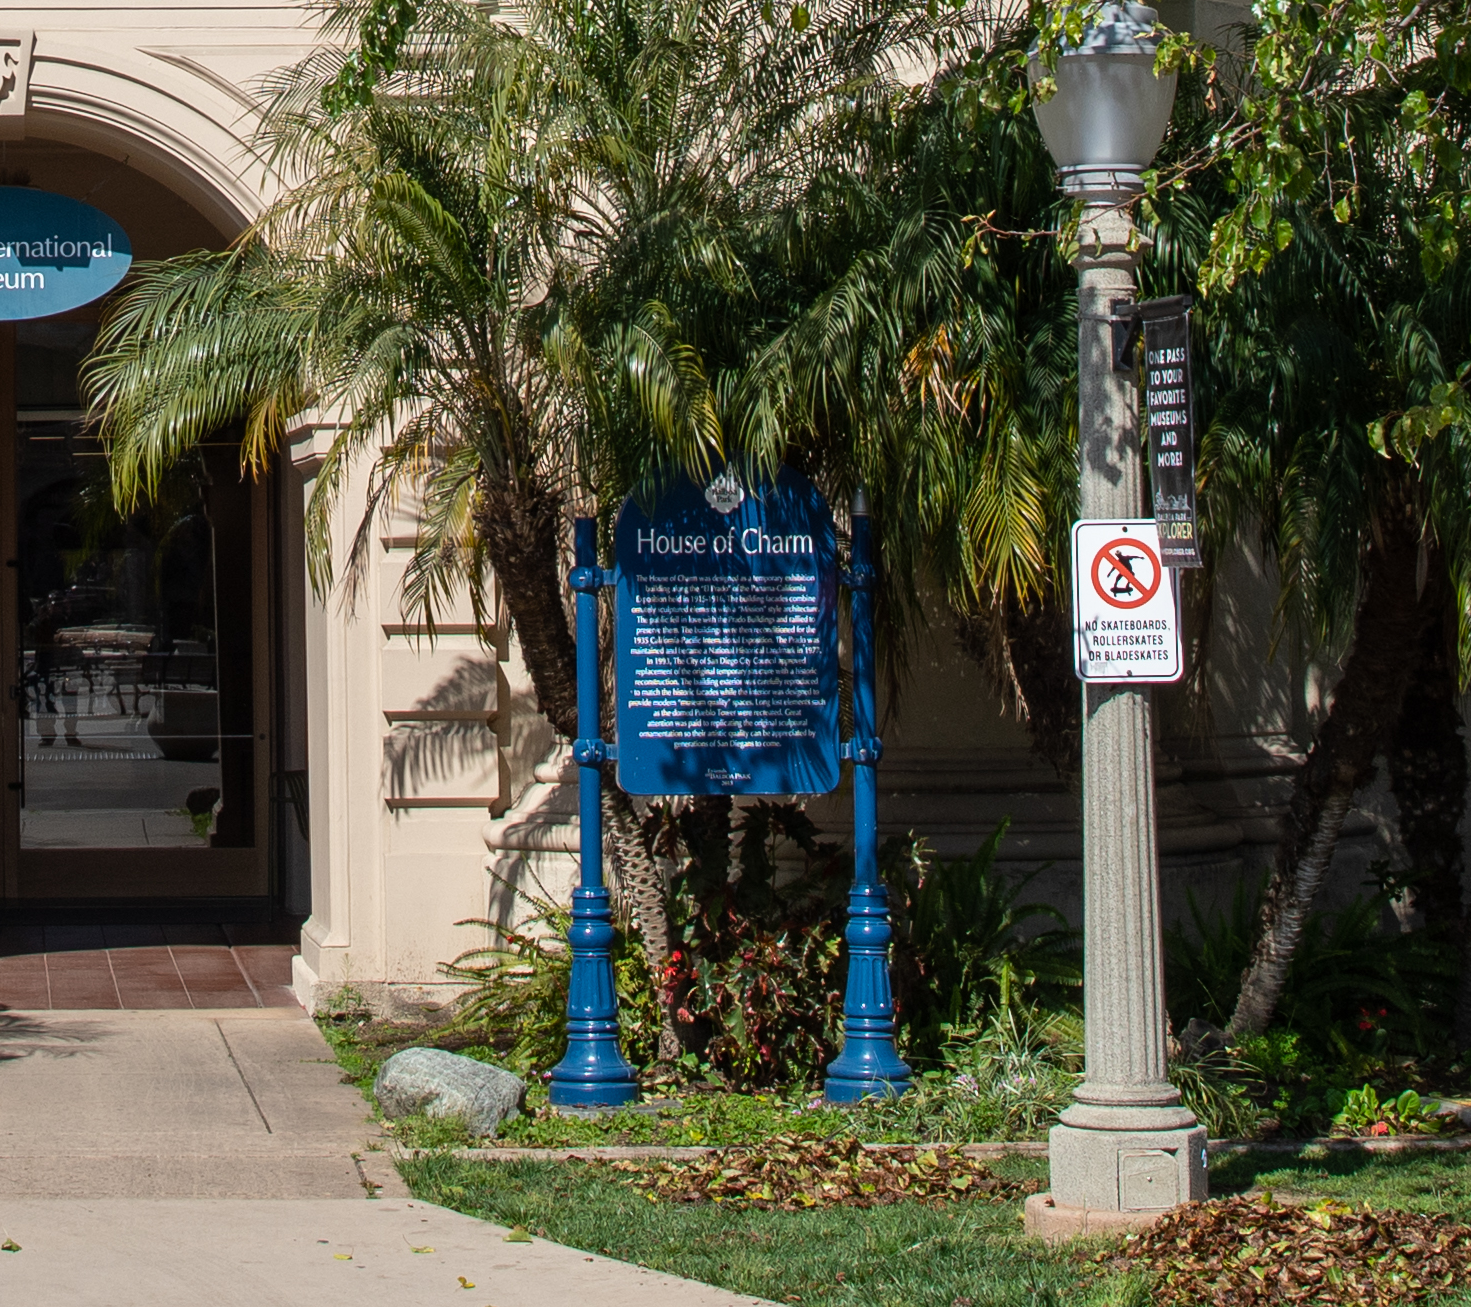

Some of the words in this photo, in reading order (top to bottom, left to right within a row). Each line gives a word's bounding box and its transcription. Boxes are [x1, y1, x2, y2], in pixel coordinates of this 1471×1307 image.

[1149, 350, 1165, 365] ONE
[1166, 347, 1185, 363] PASS
[1150, 371, 1161, 385] TO
[1162, 369, 1183, 384] YOUR
[1150, 389, 1186, 406] FAVORITE
[1150, 410, 1187, 426] MUSEUMS
[1161, 431, 1178, 446] AND
[1157, 451, 1183, 467] MORE!
[637, 528, 706, 554] House
[713, 526, 735, 554] of
[741, 526, 813, 554] Charm
[1085, 620, 1098, 631] NO
[1101, 620, 1170, 631] SKATEBOARDS,
[1093, 635, 1163, 646] ROLLERSKATES
[1088, 650, 1101, 661] OR
[1104, 650, 1168, 661] BLADESKATES
